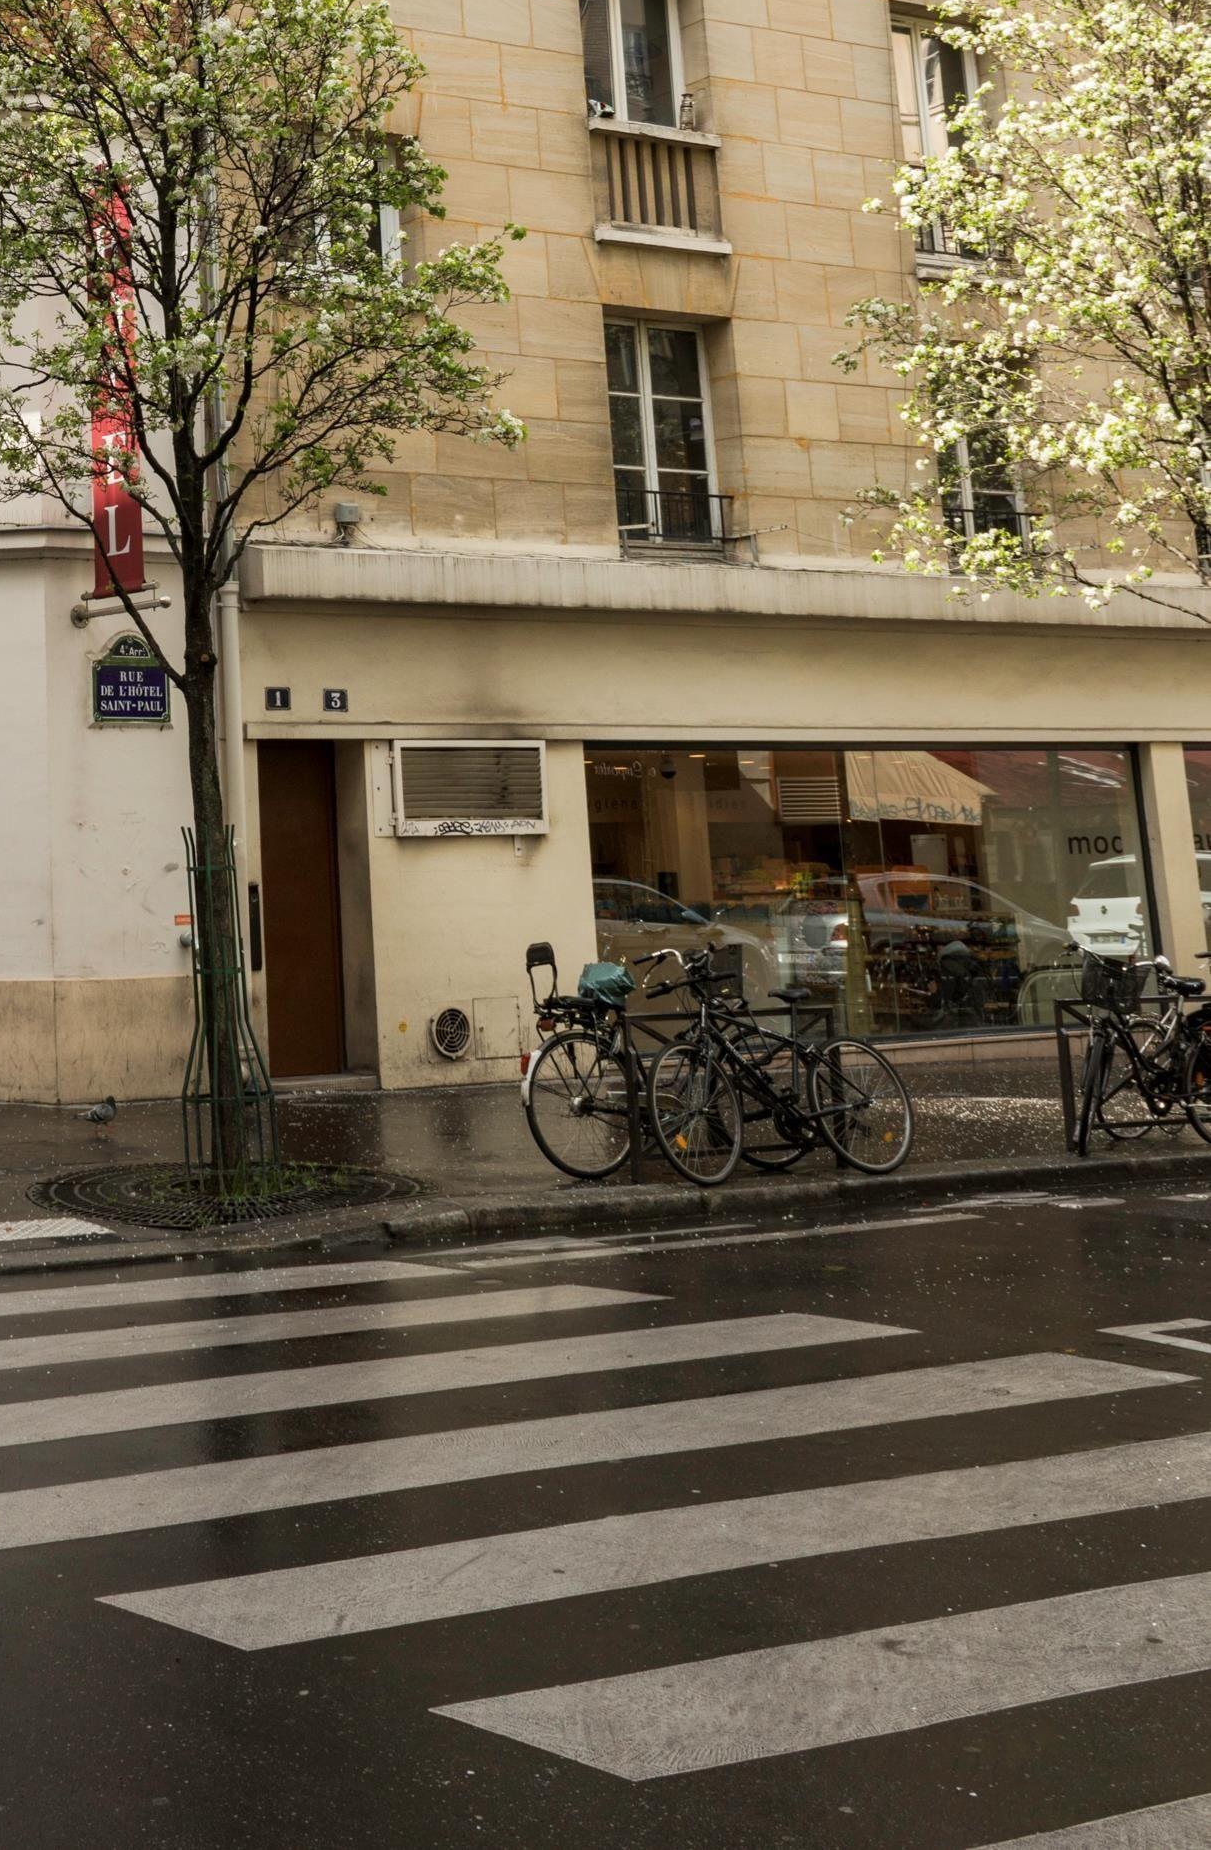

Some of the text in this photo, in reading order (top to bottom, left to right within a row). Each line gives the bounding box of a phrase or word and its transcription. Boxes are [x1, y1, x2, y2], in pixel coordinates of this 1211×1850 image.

[119, 671, 144, 682] RUE
[100, 684, 163, 697] DE L'HÔTEL
[275, 690, 282, 707] 1
[330, 692, 341, 709] 3
[100, 700, 164, 712] SAINT-PAUL
